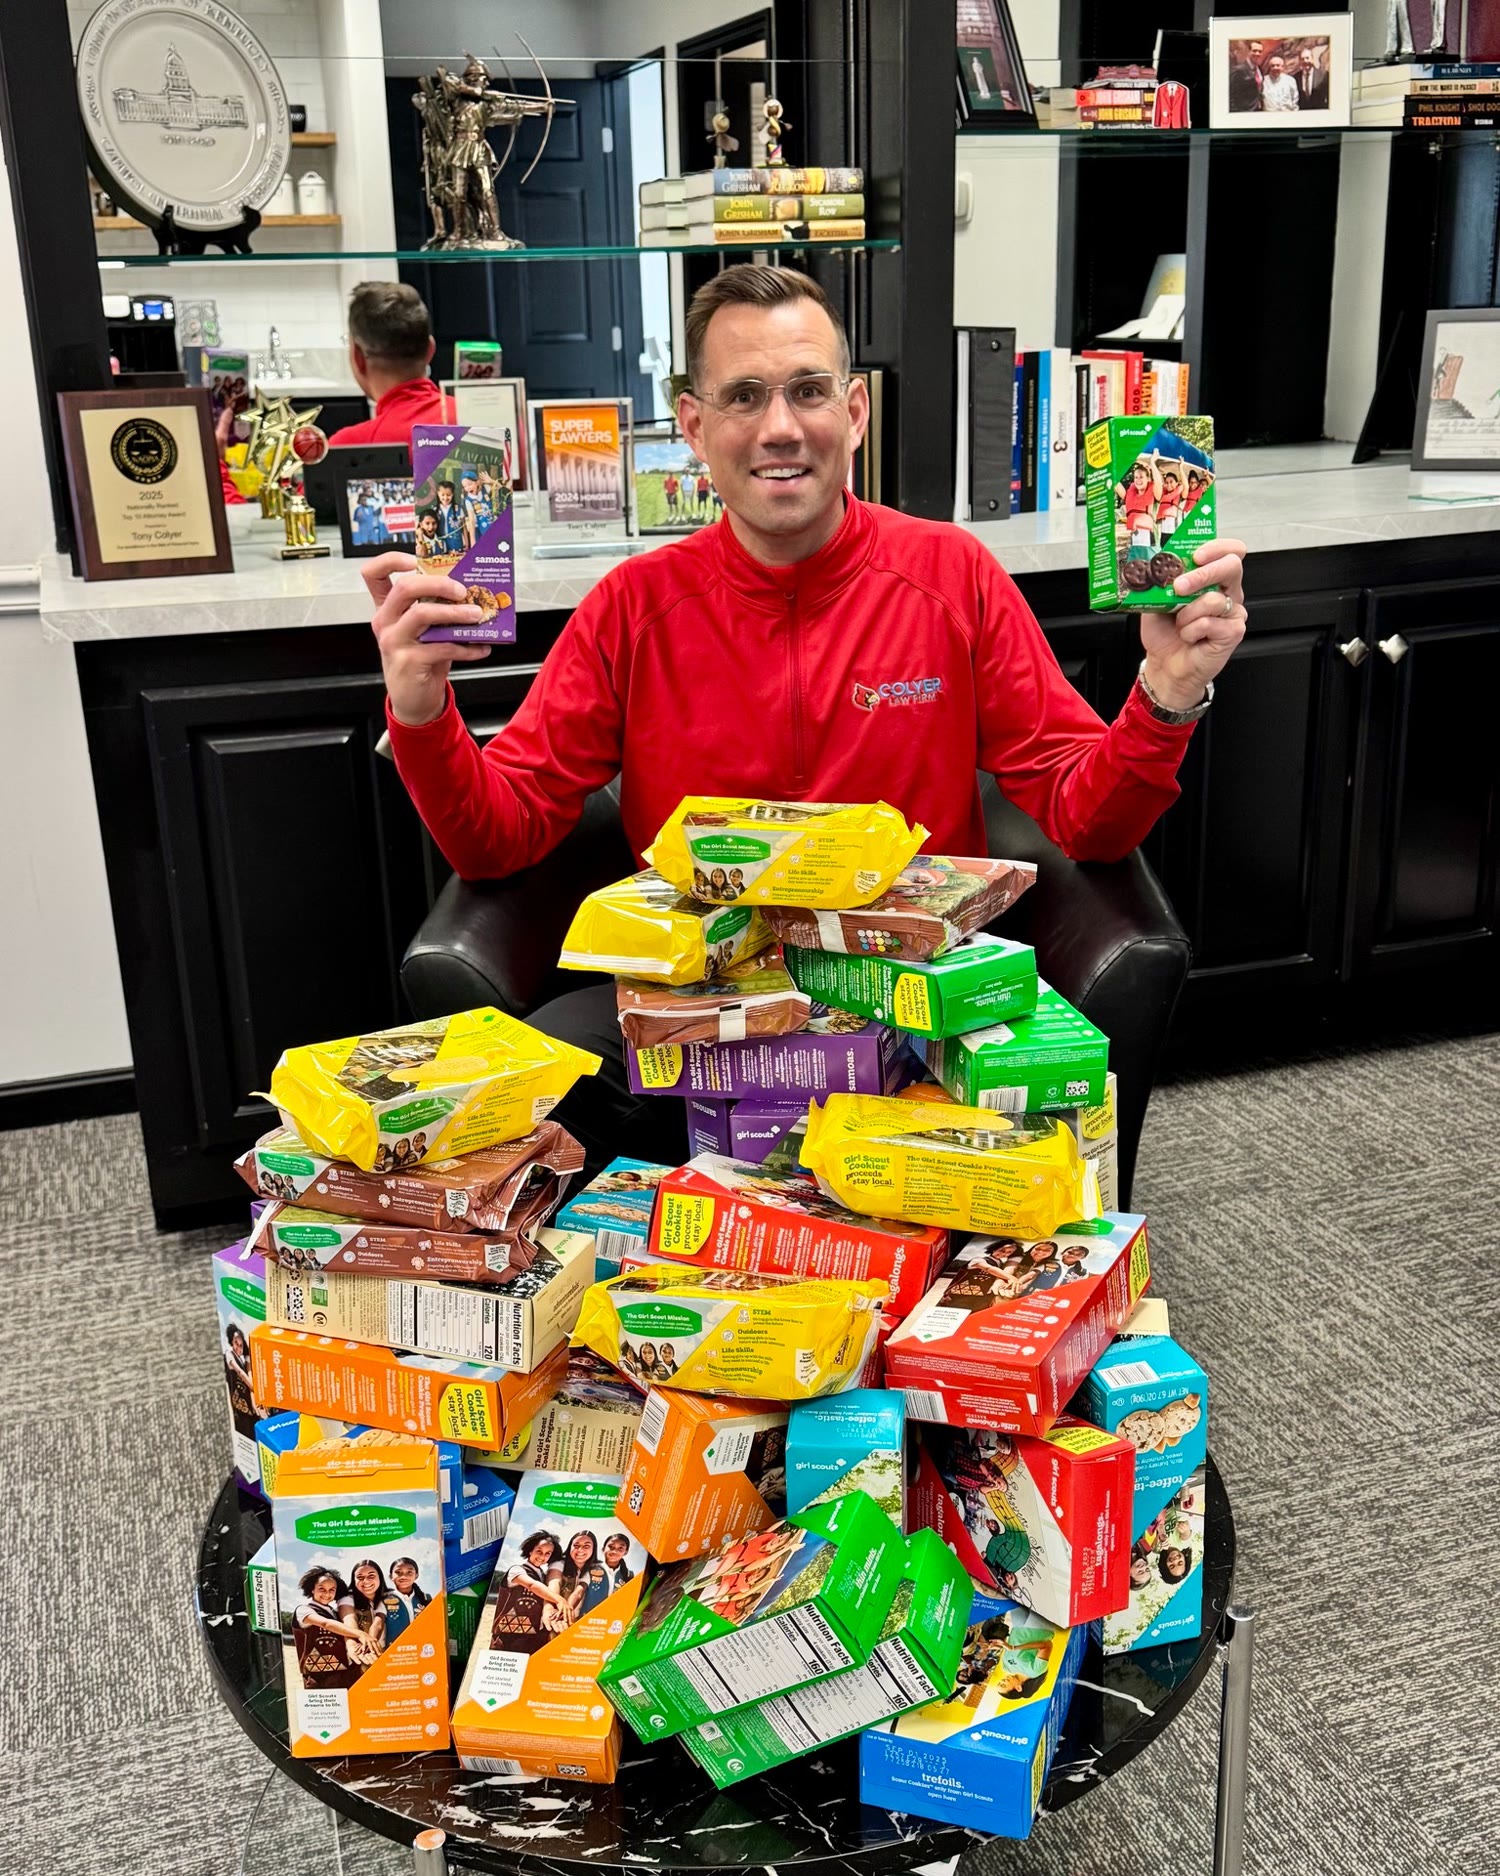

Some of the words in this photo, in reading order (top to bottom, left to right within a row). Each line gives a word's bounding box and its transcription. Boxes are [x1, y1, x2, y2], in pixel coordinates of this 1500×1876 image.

[1418, 104, 1434, 112] PHIL
[1435, 104, 1460, 112] KNIGHT
[1467, 103, 1486, 112] SHOE
[1486, 103, 1500, 111] DOG
[1113, 108, 1142, 120] GRISHAM
[1411, 116, 1461, 126] TRACTION
[721, 183, 761, 192] GRISHAM
[730, 198, 753, 208] JOHN
[723, 210, 763, 219] GRISHAM
[743, 228, 779, 237] GRISHAM
[550, 419, 594, 432] SUPER
[551, 431, 613, 445] LAWYERS
[1119, 428, 1131, 438] girl
[417, 438, 429, 447] girl
[1053, 441, 1068, 453] 3
[139, 491, 164, 501] 2025
[554, 492, 579, 502] 2024
[581, 493, 617, 501] HONOREE
[1193, 518, 1212, 527] thin
[131, 532, 152, 542] Tony
[154, 531, 182, 540] Colyer
[1187, 527, 1214, 536] mints.
[475, 556, 512, 564] samoas.
[878, 677, 941, 698] COLYER
[888, 696, 911, 707] LAW
[912, 693, 937, 705] FIRM
[772, 886, 824, 895] Entrepreneurship
[917, 979, 926, 999] Girl
[904, 977, 914, 1016] proceeds
[920, 999, 928, 1027] Scout
[847, 1047, 857, 1092] samoas.
[1084, 1110, 1107, 1130] proceeds
[736, 1131, 750, 1140] girl
[843, 1154, 861, 1165] Girl
[863, 1155, 890, 1164] Scout
[936, 1158, 957, 1167] Scout
[957, 1161, 983, 1170] Cookie
[983, 1164, 1016, 1175] Program
[845, 1170, 883, 1181] proceeds
[329, 1183, 354, 1193] Outdoors
[852, 1178, 870, 1186] stay
[392, 1196, 445, 1210] Entrepreneurship
[665, 1197, 675, 1227] Scout
[693, 1198, 702, 1222] local.
[672, 1201, 683, 1244] Cookies.
[969, 1215, 1018, 1227] lemon-ups
[684, 1209, 692, 1250] proceeds
[693, 1223, 702, 1243] stay
[664, 1228, 673, 1248] Girl
[427, 1256, 483, 1266] Entrepreneurship
[512, 1302, 522, 1340] Nutrition
[484, 1344, 493, 1360] 120
[512, 1342, 522, 1365] Facts
[707, 1363, 763, 1375] Entrepreneurship
[272, 1349, 285, 1403] do-si-dos.
[447, 1395, 456, 1412] stay
[474, 1388, 483, 1408] Girl
[453, 1388, 468, 1427] proceeds
[466, 1393, 477, 1433] Cookies
[478, 1408, 488, 1438] Scout
[814, 1415, 877, 1424] toffee-tastic.
[539, 1417, 548, 1438] Scout
[537, 1438, 545, 1455] Girl
[534, 1456, 542, 1468] The
[541, 1447, 550, 1469] Cookie
[795, 1462, 811, 1470] girl
[1051, 1457, 1060, 1478] girl
[1051, 1478, 1059, 1507] scouts
[686, 1483, 707, 1539] Entrepreneurship
[368, 1517, 399, 1525] Mission
[1095, 1512, 1104, 1567] tagalongs.
[1158, 1619, 1182, 1630] scouts
[1182, 1614, 1195, 1626] girl
[803, 1604, 834, 1647] Nutrition
[831, 1642, 851, 1666] Facts
[570, 1646, 600, 1655] Outdoors
[776, 1616, 798, 1642] Calories
[807, 1658, 824, 1675] 160
[889, 1637, 919, 1676] Nutrition
[915, 1674, 936, 1697] Facts
[561, 1674, 575, 1682] Life
[575, 1675, 596, 1684] Skills
[401, 1699, 421, 1707] Skills
[526, 1700, 588, 1712] Entrepreneurship
[359, 1724, 423, 1734] Entrepreneurship
[980, 1729, 1010, 1741] scouts
[1011, 1734, 1029, 1745] girl
[921, 1772, 965, 1789] trefoils.
[890, 1775, 908, 1783] Scout
[934, 1784, 947, 1793] only
[947, 1787, 962, 1796] from
[962, 1790, 974, 1799] Girl
[974, 1792, 994, 1803] Scouts
[927, 1791, 943, 1800] open
[943, 1794, 957, 1802] here
